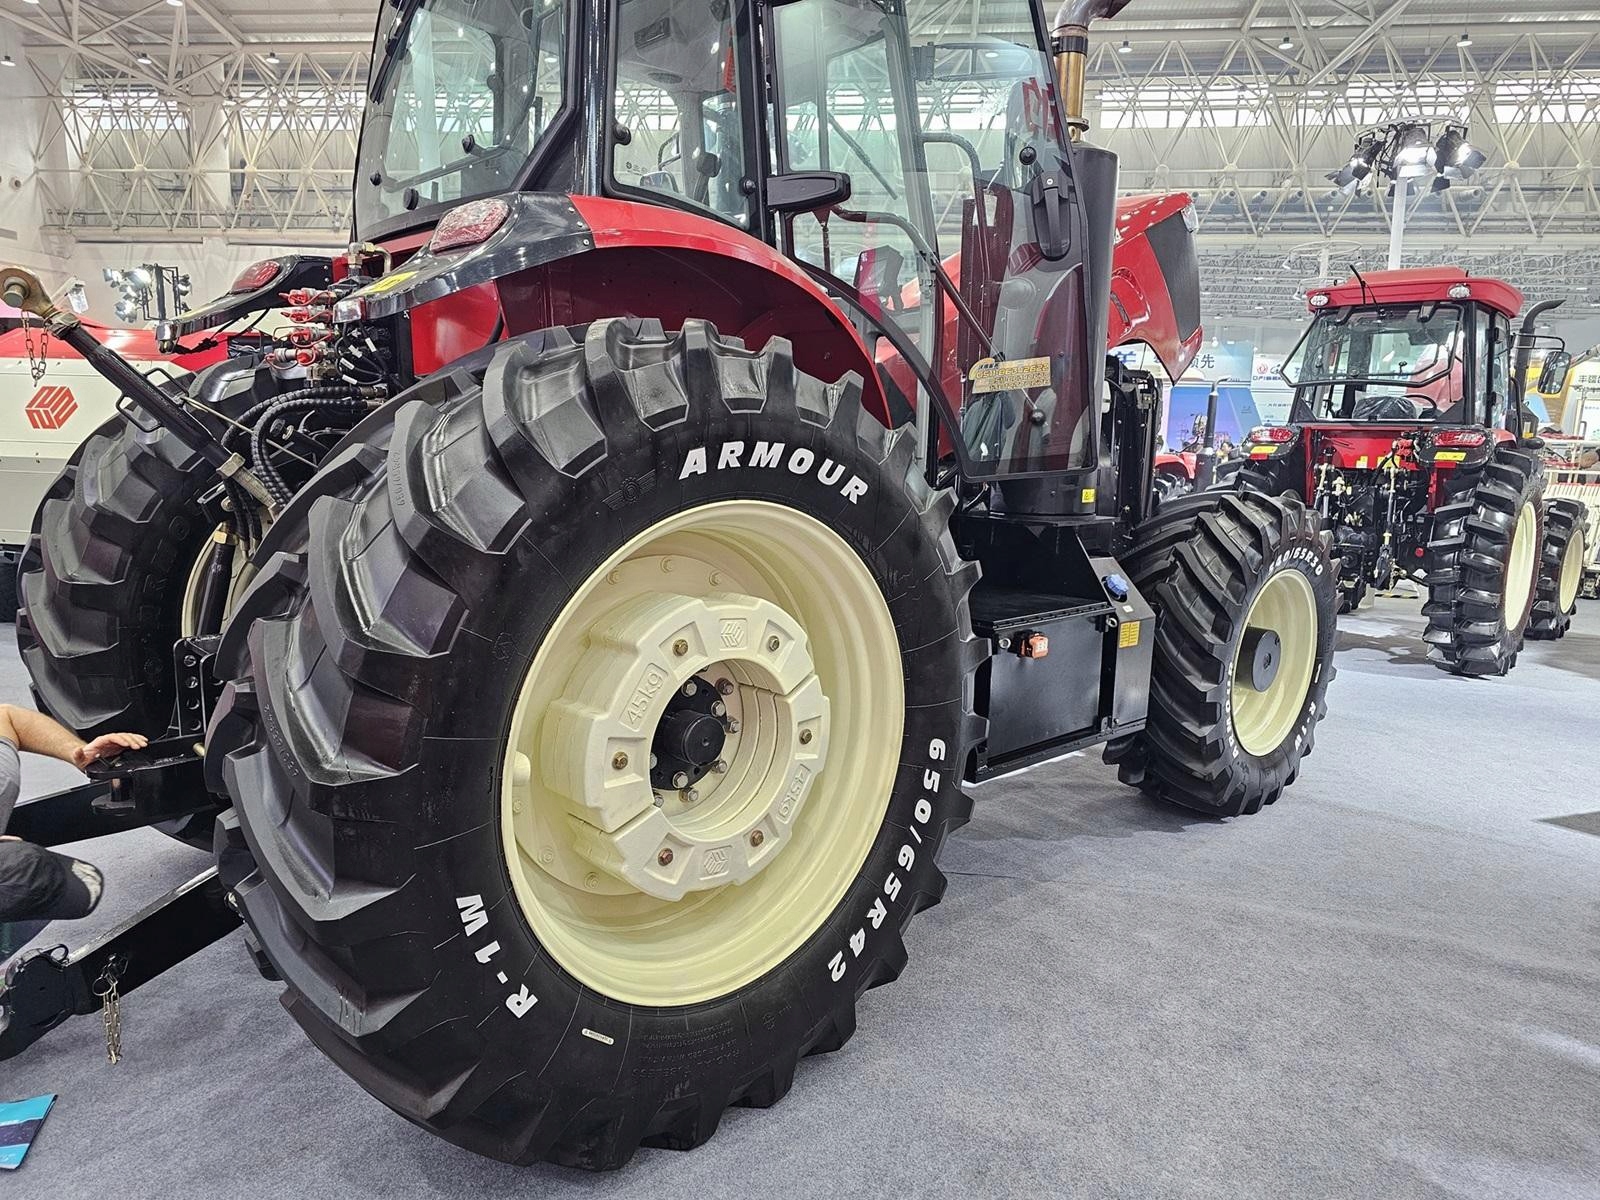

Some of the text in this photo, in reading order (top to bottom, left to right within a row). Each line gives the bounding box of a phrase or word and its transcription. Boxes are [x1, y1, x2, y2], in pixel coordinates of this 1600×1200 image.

[678, 440, 869, 506] ARMOUR
[628, 670, 664, 725] 45kg
[827, 738, 946, 983] 650/65R42
[455, 894, 538, 1019] R-1W
